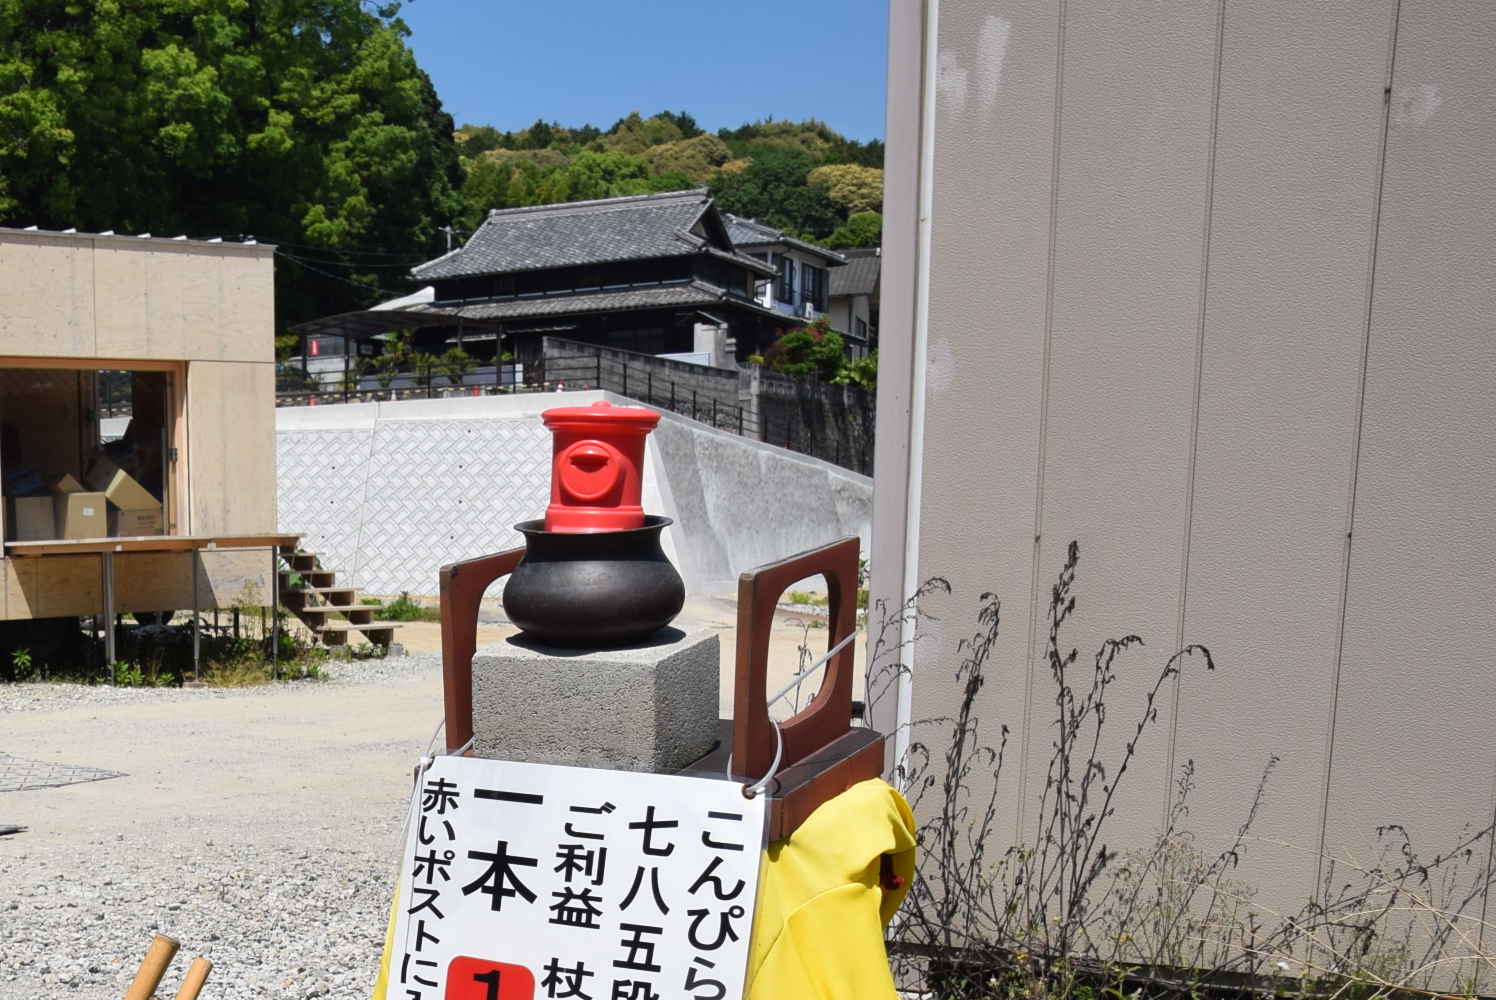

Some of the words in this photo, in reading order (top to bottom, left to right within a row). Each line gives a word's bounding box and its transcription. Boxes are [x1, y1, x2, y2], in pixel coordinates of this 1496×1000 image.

[461, 788, 544, 912] 一本
[548, 801, 617, 930] ご利益
